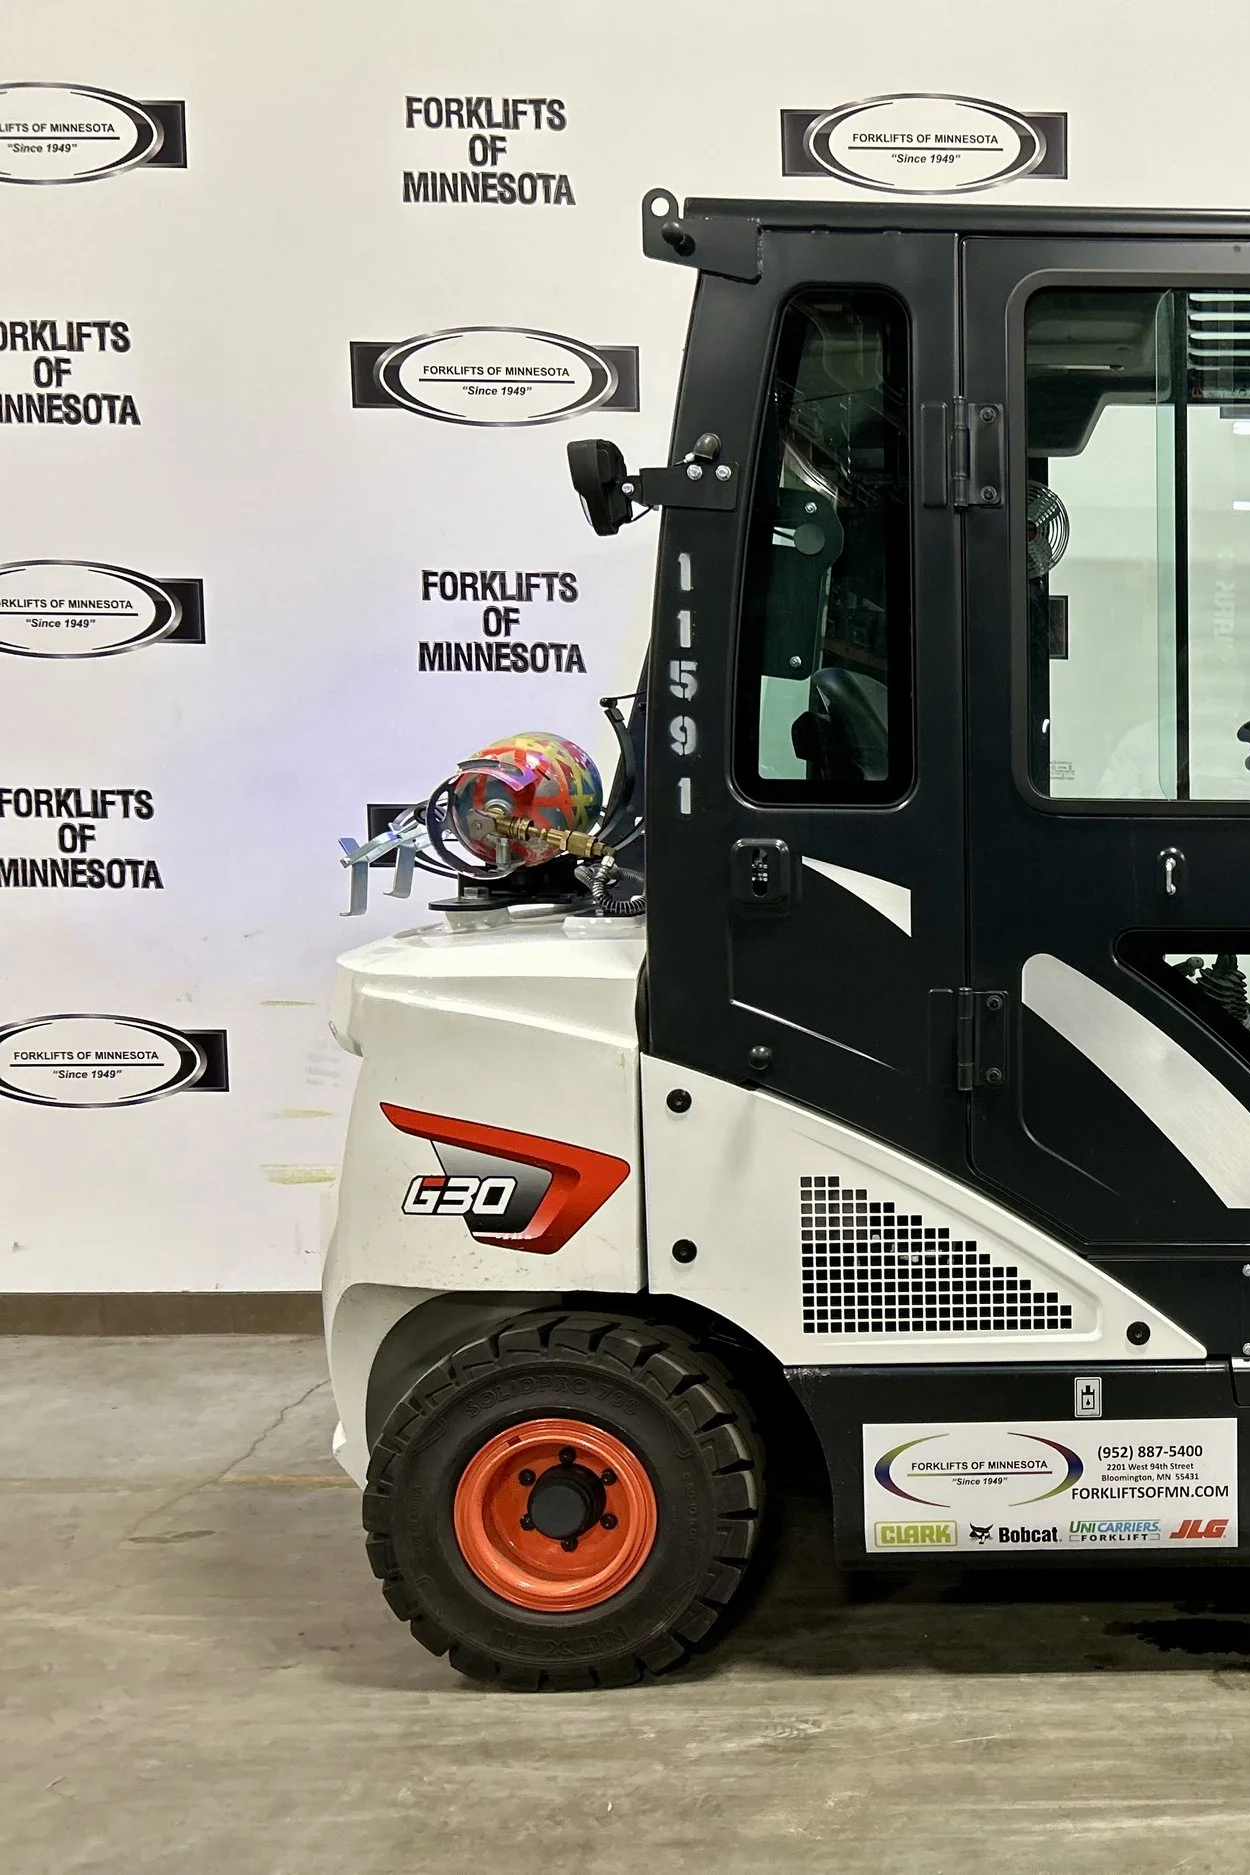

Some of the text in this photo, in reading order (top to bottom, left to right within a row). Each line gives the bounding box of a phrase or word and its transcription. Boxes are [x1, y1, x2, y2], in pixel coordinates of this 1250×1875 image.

[405, 96, 567, 131] FORKLIFTS
[32, 122, 49, 134] OF
[50, 122, 116, 134] MINNESOTA
[851, 133, 999, 145] FORKLIFTS OF MINNESOTA
[468, 134, 507, 167] OF
[403, 170, 576, 205] MINNESOTA
[33, 356, 72, 388] OF
[422, 365, 571, 377] FORKLIFTS OF MINNESOTA
[421, 570, 579, 603] FORKLIFTS
[0, 598, 134, 610] RKLIFTS OF MINNESOTA
[482, 606, 520, 637] OF
[418, 641, 587, 673] MINNESOTA
[669, 552, 698, 815] 11591
[0, 787, 155, 820] FORKLIFTS
[58, 822, 96, 854] OF
[0, 857, 164, 889] MINNESOTA
[13, 1050, 160, 1061] FORKLIFTS OF MINNESOTA
[402, 1175, 518, 1215] G30
[1097, 1445, 1203, 1461] (952) 887-5400
[911, 1460, 1048, 1471] FORKLIFTS OF MINNESOTA
[1106, 1462, 1194, 1471] 2201 West 94th Street
[1101, 1474, 1154, 1482] Bloomington,
[1071, 1486, 1229, 1500] FORKLIFTSOFMN.COM
[881, 1525, 951, 1544] CLARK
[999, 1527, 1058, 1543] Bobcat
[1081, 1533, 1149, 1542] FORKLIFT
[1169, 1519, 1229, 1539] JLG
